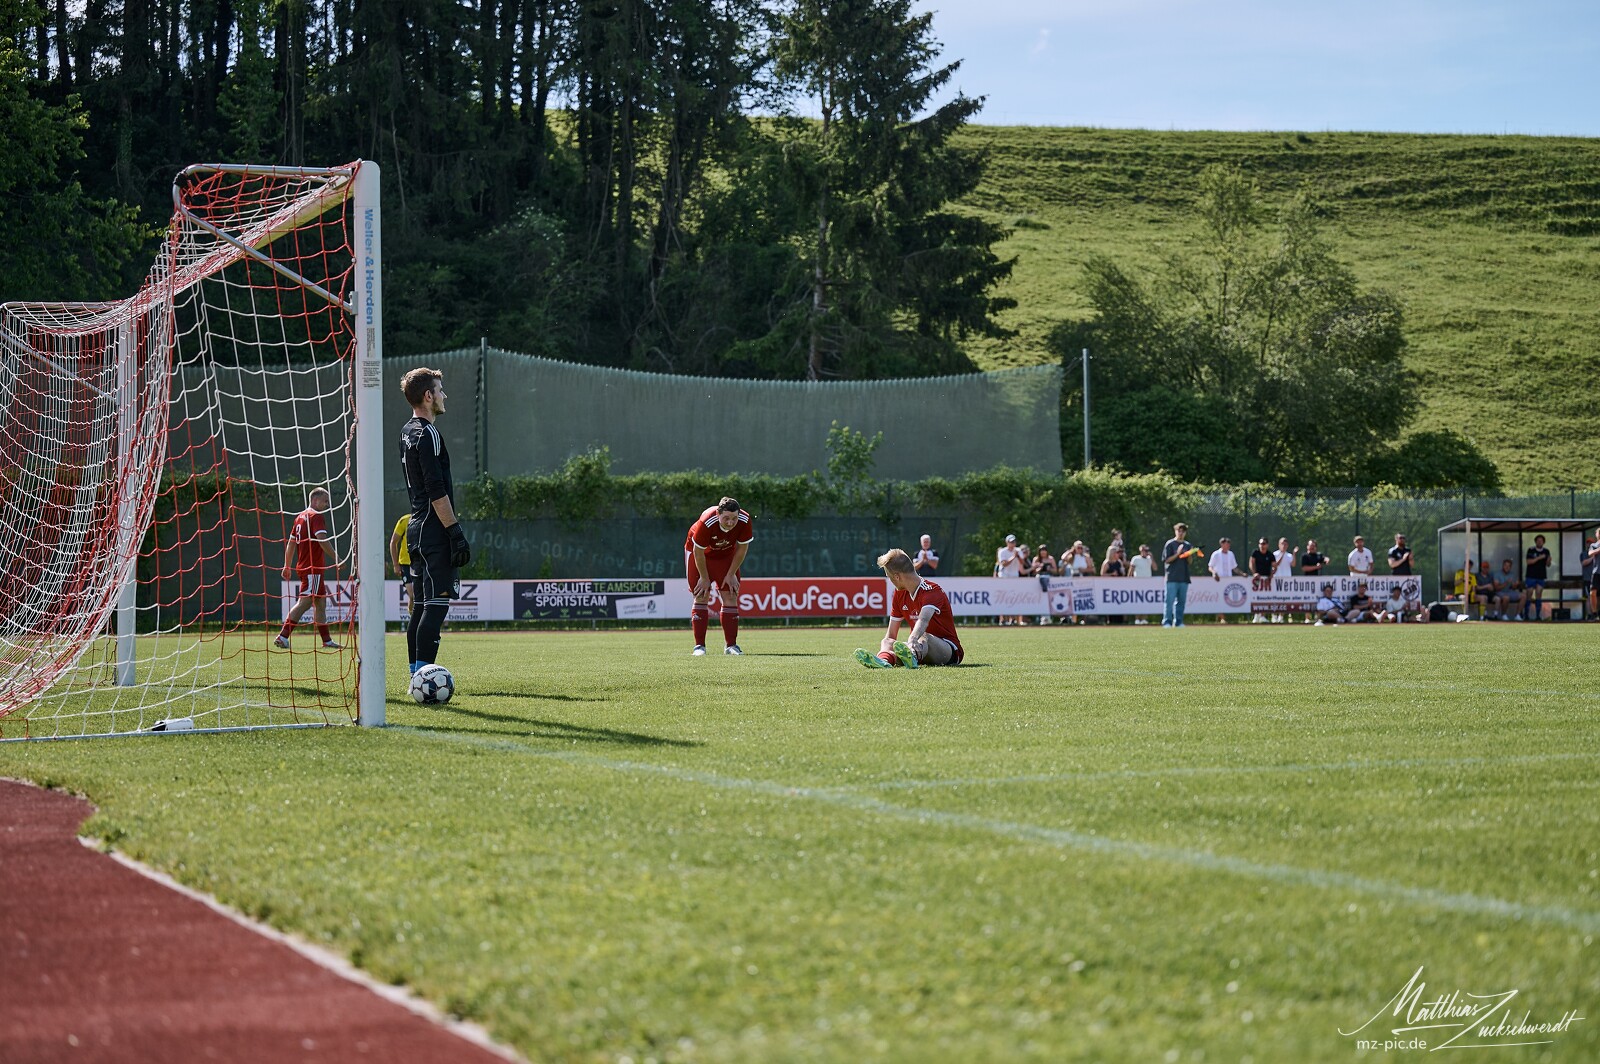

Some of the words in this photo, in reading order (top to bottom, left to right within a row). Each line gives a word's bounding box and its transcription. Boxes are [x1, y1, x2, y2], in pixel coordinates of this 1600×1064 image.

[365, 257, 374, 267] &
[365, 269, 375, 325] Herden
[535, 582, 592, 594] ABSOLUTE
[593, 581, 657, 593] TEAMSPORT
[1275, 578, 1315, 594] Werbung
[535, 595, 608, 607] SPORTSTEAM
[739, 585, 883, 611] svlaufen.de
[948, 591, 992, 606] INGER
[1073, 598, 1096, 612] FANS
